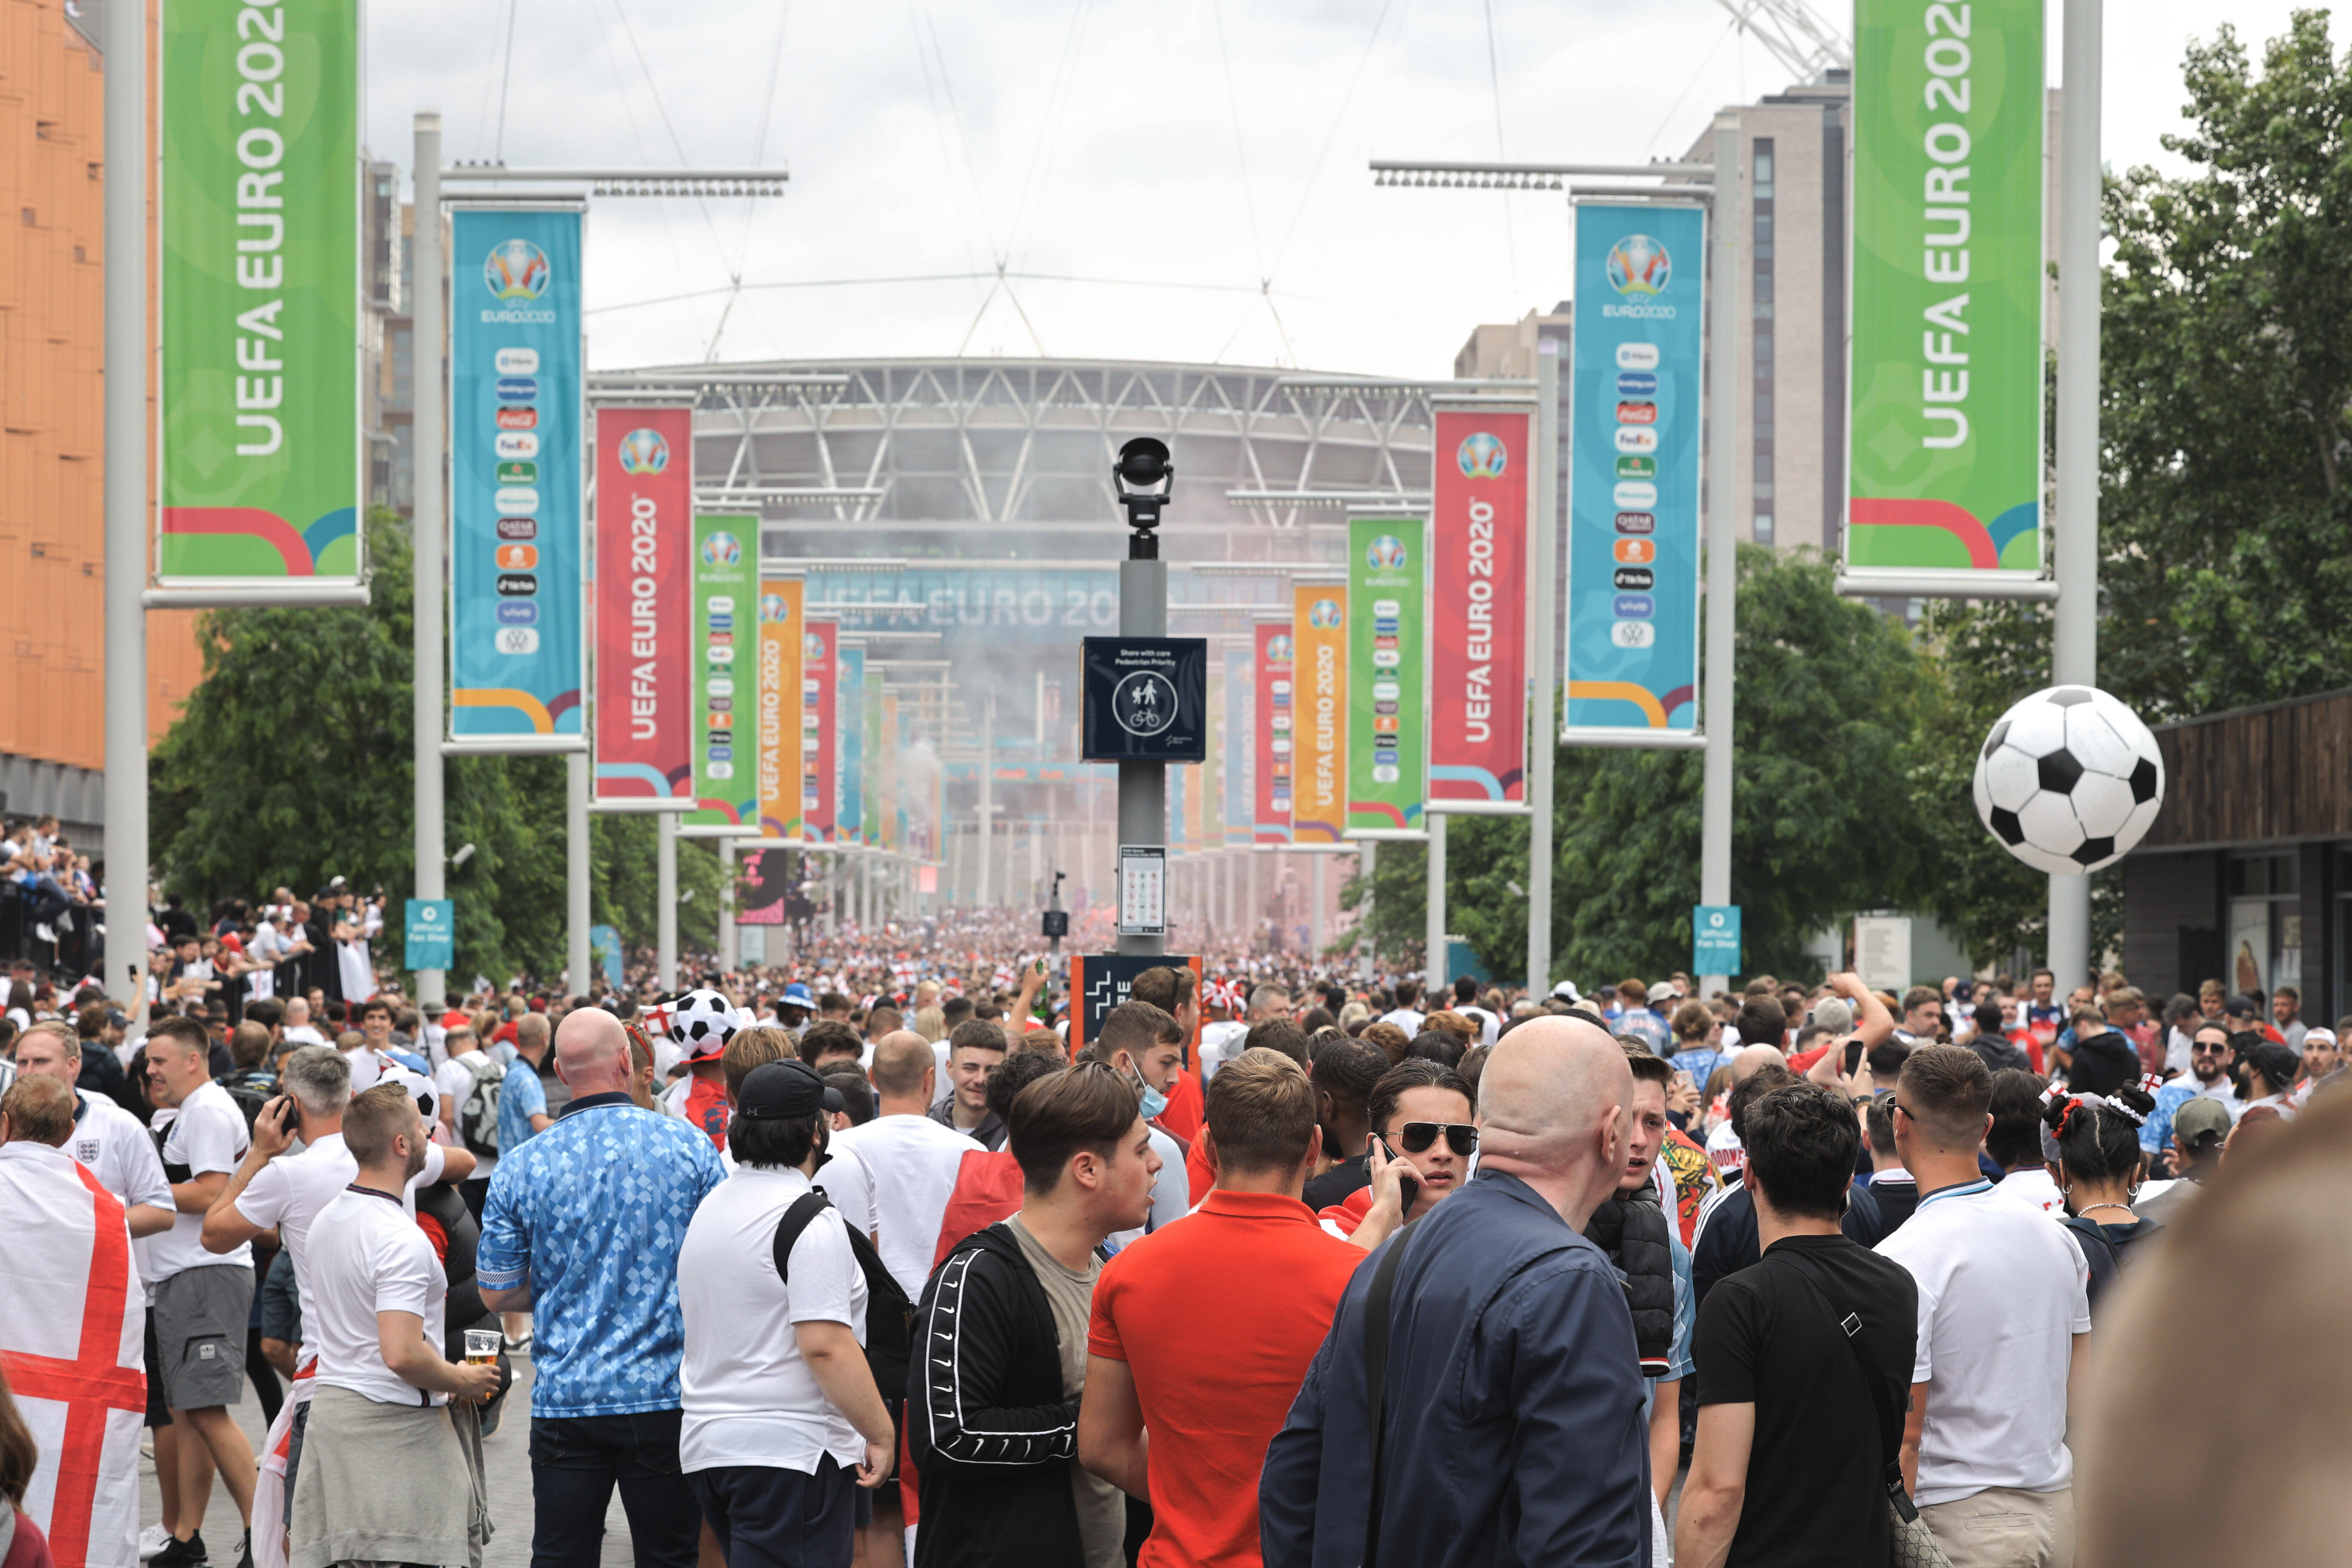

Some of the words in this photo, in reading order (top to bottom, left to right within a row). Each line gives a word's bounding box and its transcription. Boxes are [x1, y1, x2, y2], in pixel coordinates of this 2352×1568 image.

[237, 0, 283, 117] 202
[1925, 0, 1971, 113] 202
[237, 128, 283, 288] EURO
[1924, 123, 1970, 283] EURO
[236, 300, 282, 455] UEFA
[1923, 294, 1969, 449] UEFA
[631, 498, 656, 573] 2020
[1468, 502, 1494, 576] 2020
[632, 577, 656, 658] EURO
[928, 588, 1051, 626] EURO
[1467, 581, 1493, 661] EURO
[763, 639, 781, 690] 2020
[1115, 658, 1150, 666] Pedestrian
[1151, 658, 1176, 667] Priority
[1317, 645, 1335, 695] 2020
[632, 662, 656, 739] UEFA
[763, 692, 781, 747] EURO
[1317, 697, 1335, 752] EURO
[1466, 665, 1491, 742] UEFA
[763, 748, 781, 802] UEFA
[1316, 753, 1334, 806] UEFA
[408, 932, 425, 942] Fan
[427, 933, 450, 943] Shop
[412, 923, 447, 932] Official
[1697, 939, 1713, 949] Fan
[1715, 939, 1738, 949] Shop
[1700, 930, 1733, 938] Official
